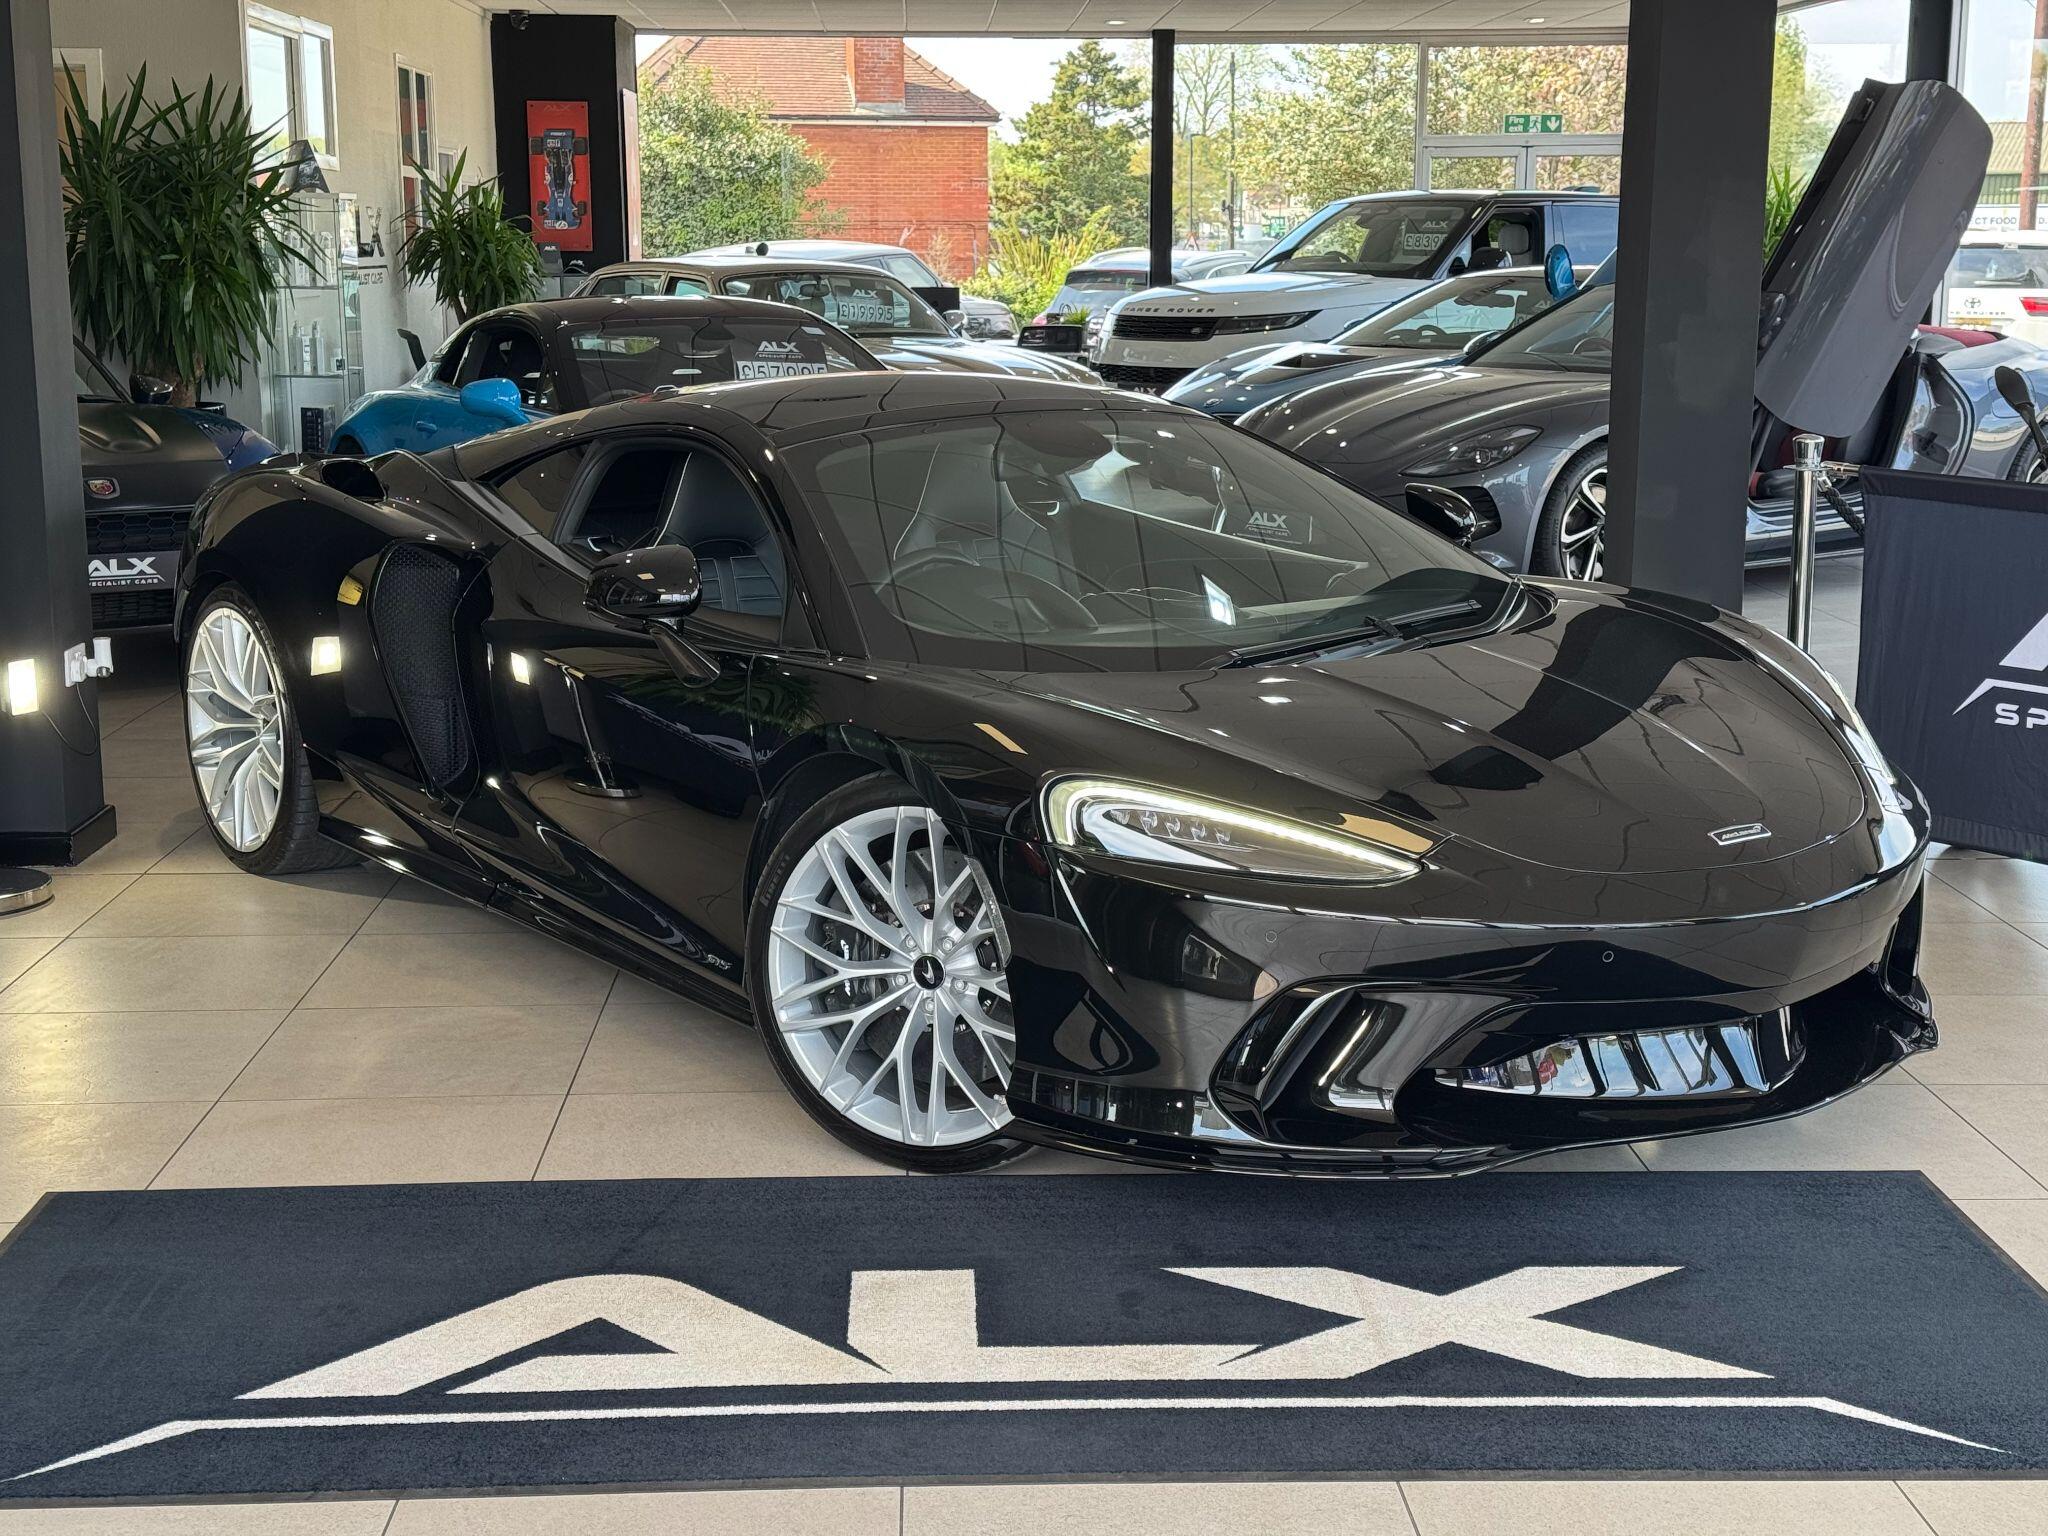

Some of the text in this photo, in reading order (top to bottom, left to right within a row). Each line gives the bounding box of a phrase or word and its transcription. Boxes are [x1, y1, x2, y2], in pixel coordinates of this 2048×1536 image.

[1508, 116, 1525, 124] Fire
[1422, 220, 1449, 228] ALX
[1989, 217, 2017, 225] FOOD
[852, 288, 879, 298] ALX
[840, 304, 893, 321] £19995
[758, 341, 801, 353] ALX
[1247, 511, 1288, 529] ALX
[88, 556, 158, 577] ALX
[134, 578, 159, 586] CARS
[233, 1263, 1776, 1400] ALX
